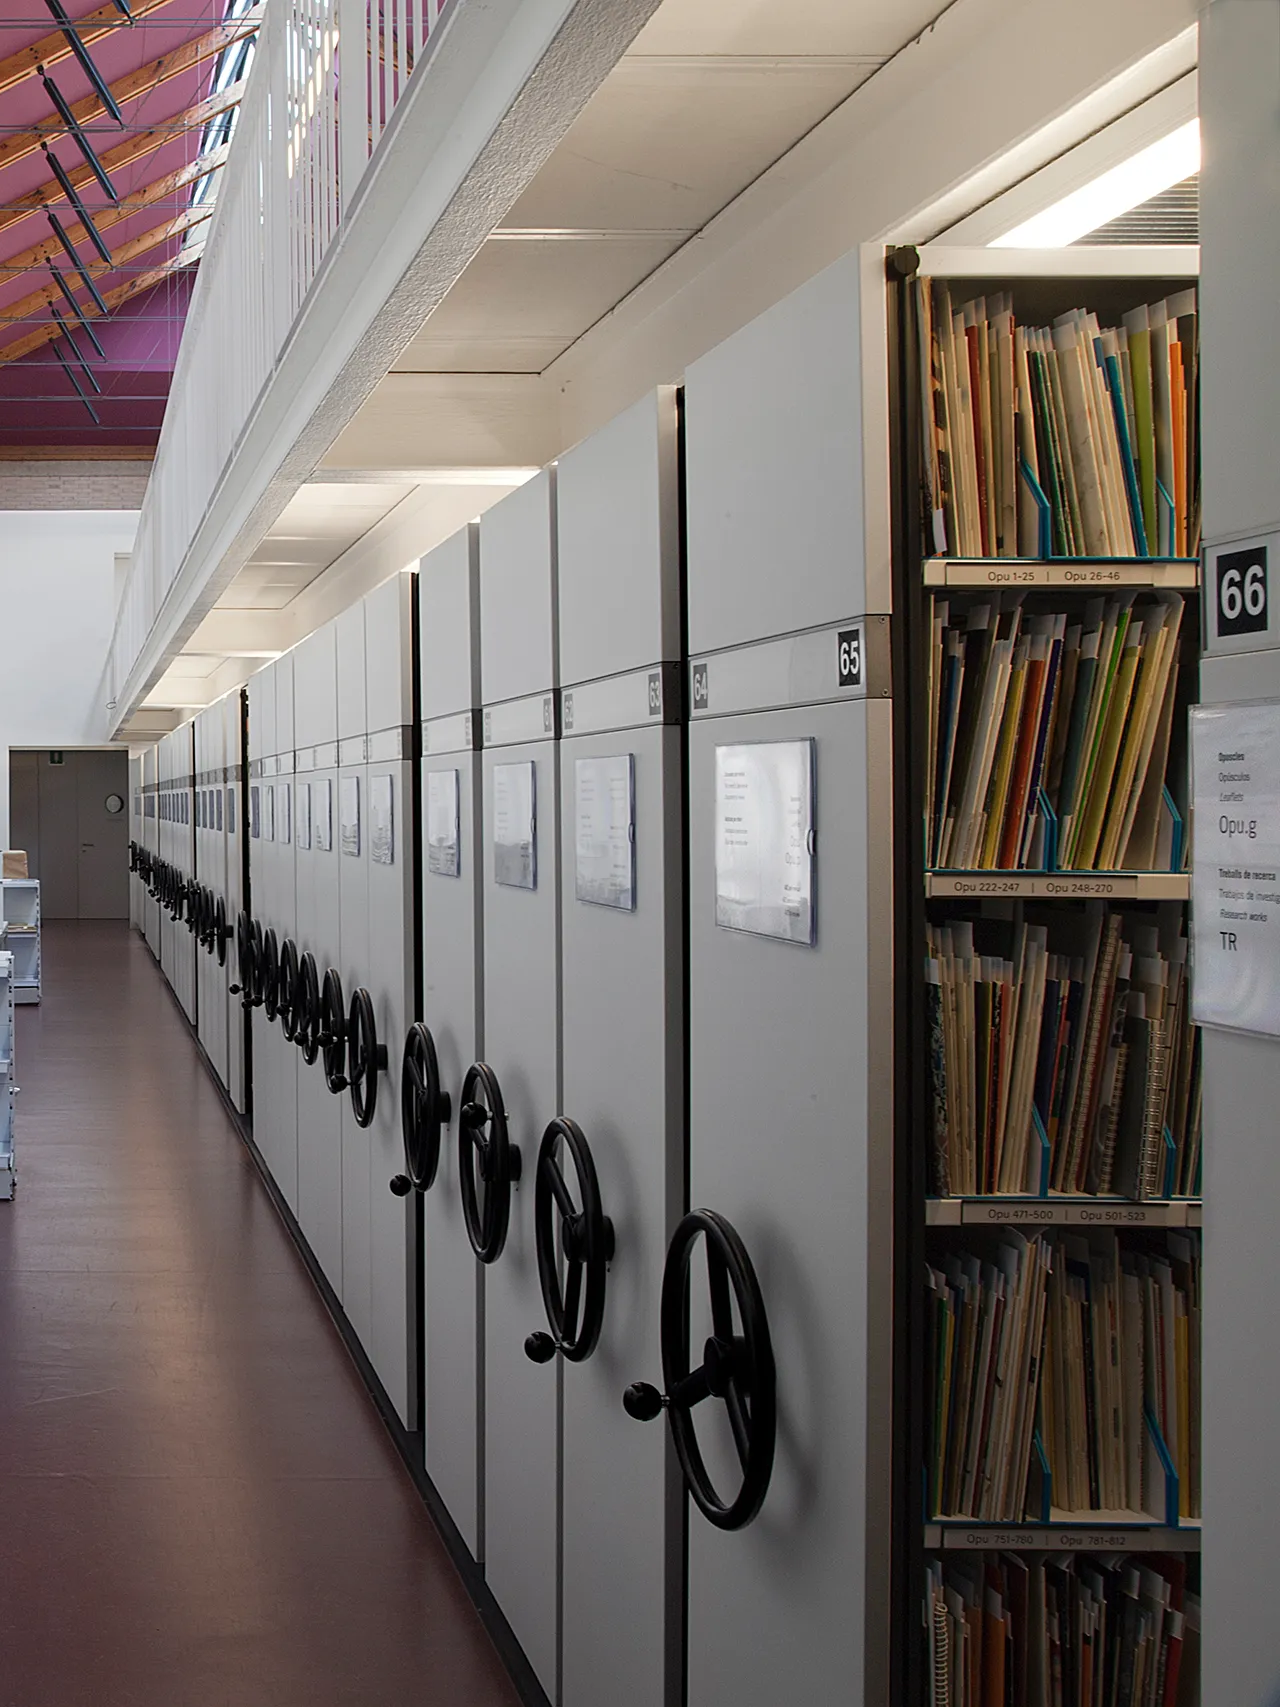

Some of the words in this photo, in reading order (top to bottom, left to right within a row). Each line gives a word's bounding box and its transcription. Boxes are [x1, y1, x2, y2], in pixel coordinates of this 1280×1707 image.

[988, 571, 1011, 583] Opu
[1013, 571, 1035, 582] 1-25
[1064, 570, 1087, 583] Opu
[1090, 571, 1120, 581] 26-46
[1221, 564, 1266, 620] 66
[840, 641, 859, 676] 65
[694, 672, 708, 701] 64
[650, 681, 660, 708] 63
[1219, 815, 1257, 839] Opu.g
[954, 881, 977, 893] Opu
[979, 882, 1020, 892] 222-247
[1046, 882, 1069, 894] Opu
[1072, 883, 1113, 893] 248-270
[1220, 932, 1237, 951] TR
[988, 1209, 1010, 1221] Opu
[1013, 1210, 1053, 1220] 471-500
[1080, 1211, 1103, 1222] Opu
[1105, 1212, 1146, 1221] 501-523
[966, 1533, 989, 1545] Opu
[993, 1534, 1034, 1545] 751-780
[1060, 1536, 1083, 1547] Opu
[1088, 1537, 1126, 1546] 781-812
